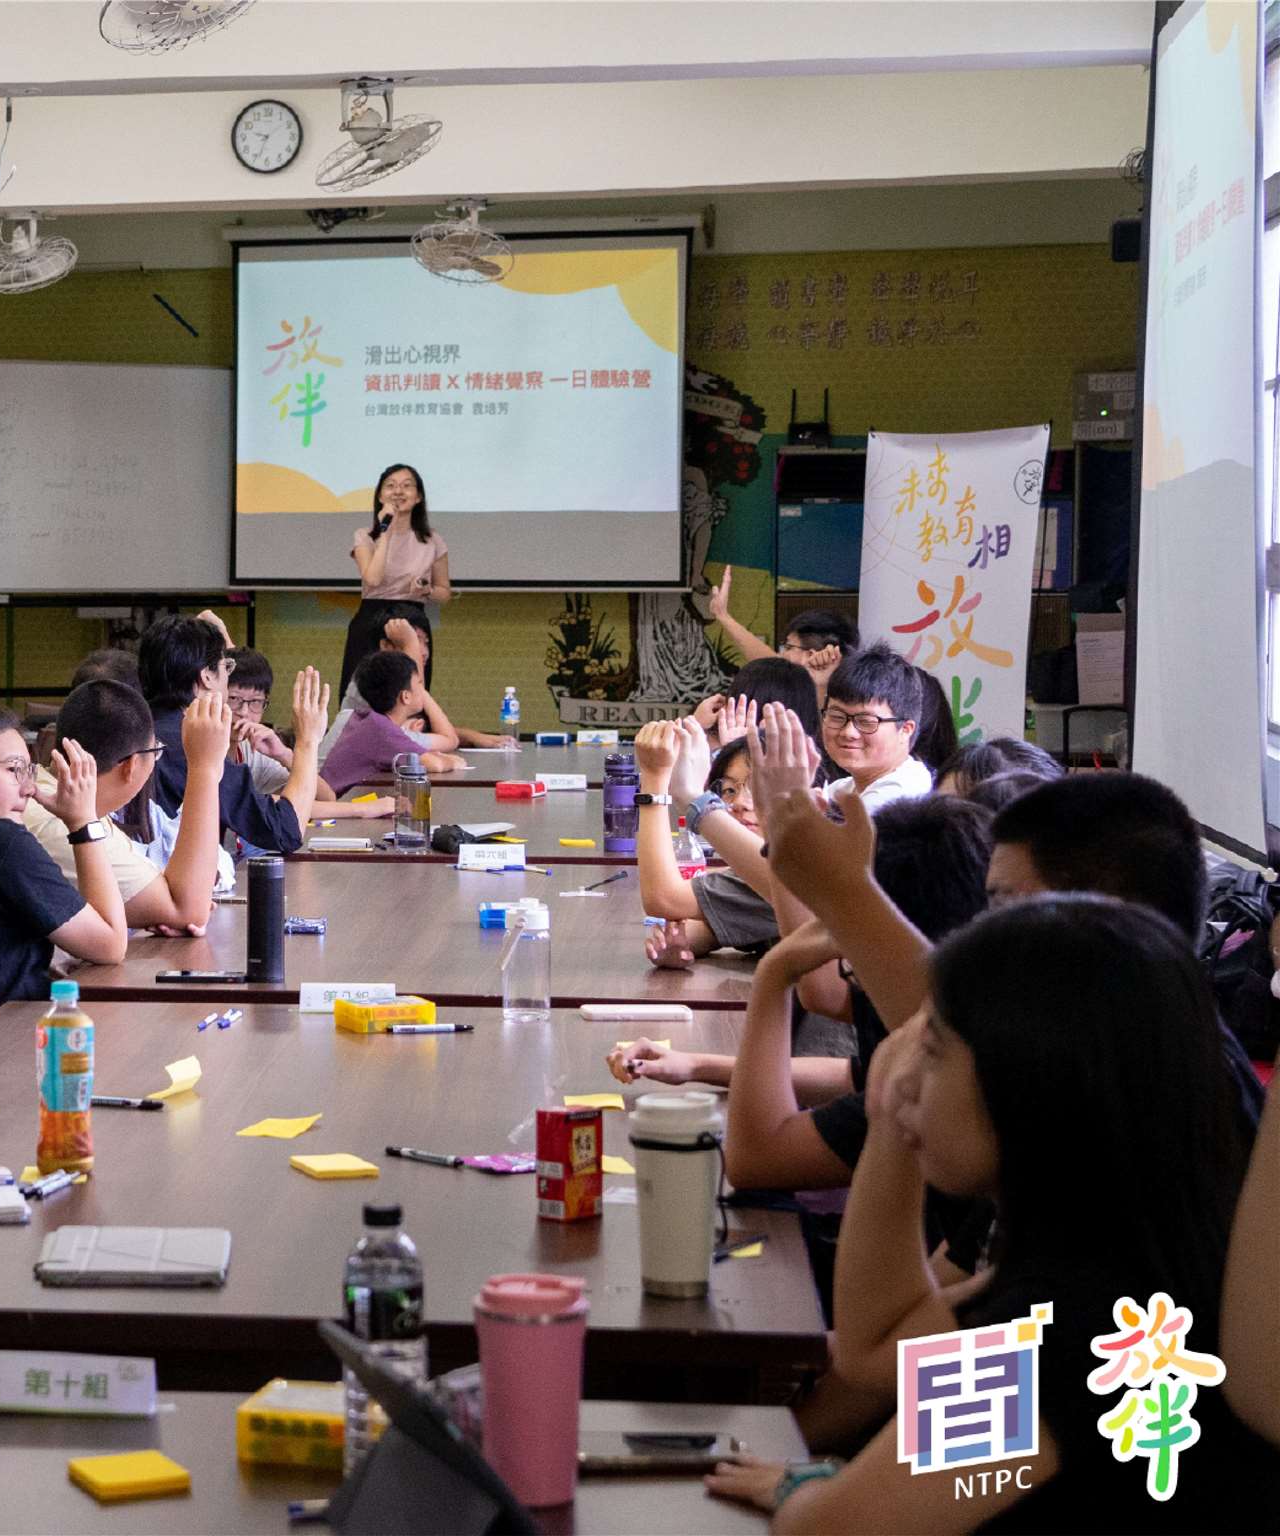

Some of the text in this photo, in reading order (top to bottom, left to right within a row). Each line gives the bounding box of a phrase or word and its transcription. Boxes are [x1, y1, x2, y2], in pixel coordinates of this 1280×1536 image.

[364, 344, 461, 365] 滑出心視界
[364, 373, 441, 392] 資訊判讀
[465, 371, 543, 391] 情緒覺察
[549, 368, 651, 390] 一日體驗營
[24, 1368, 109, 1399] 第十組
